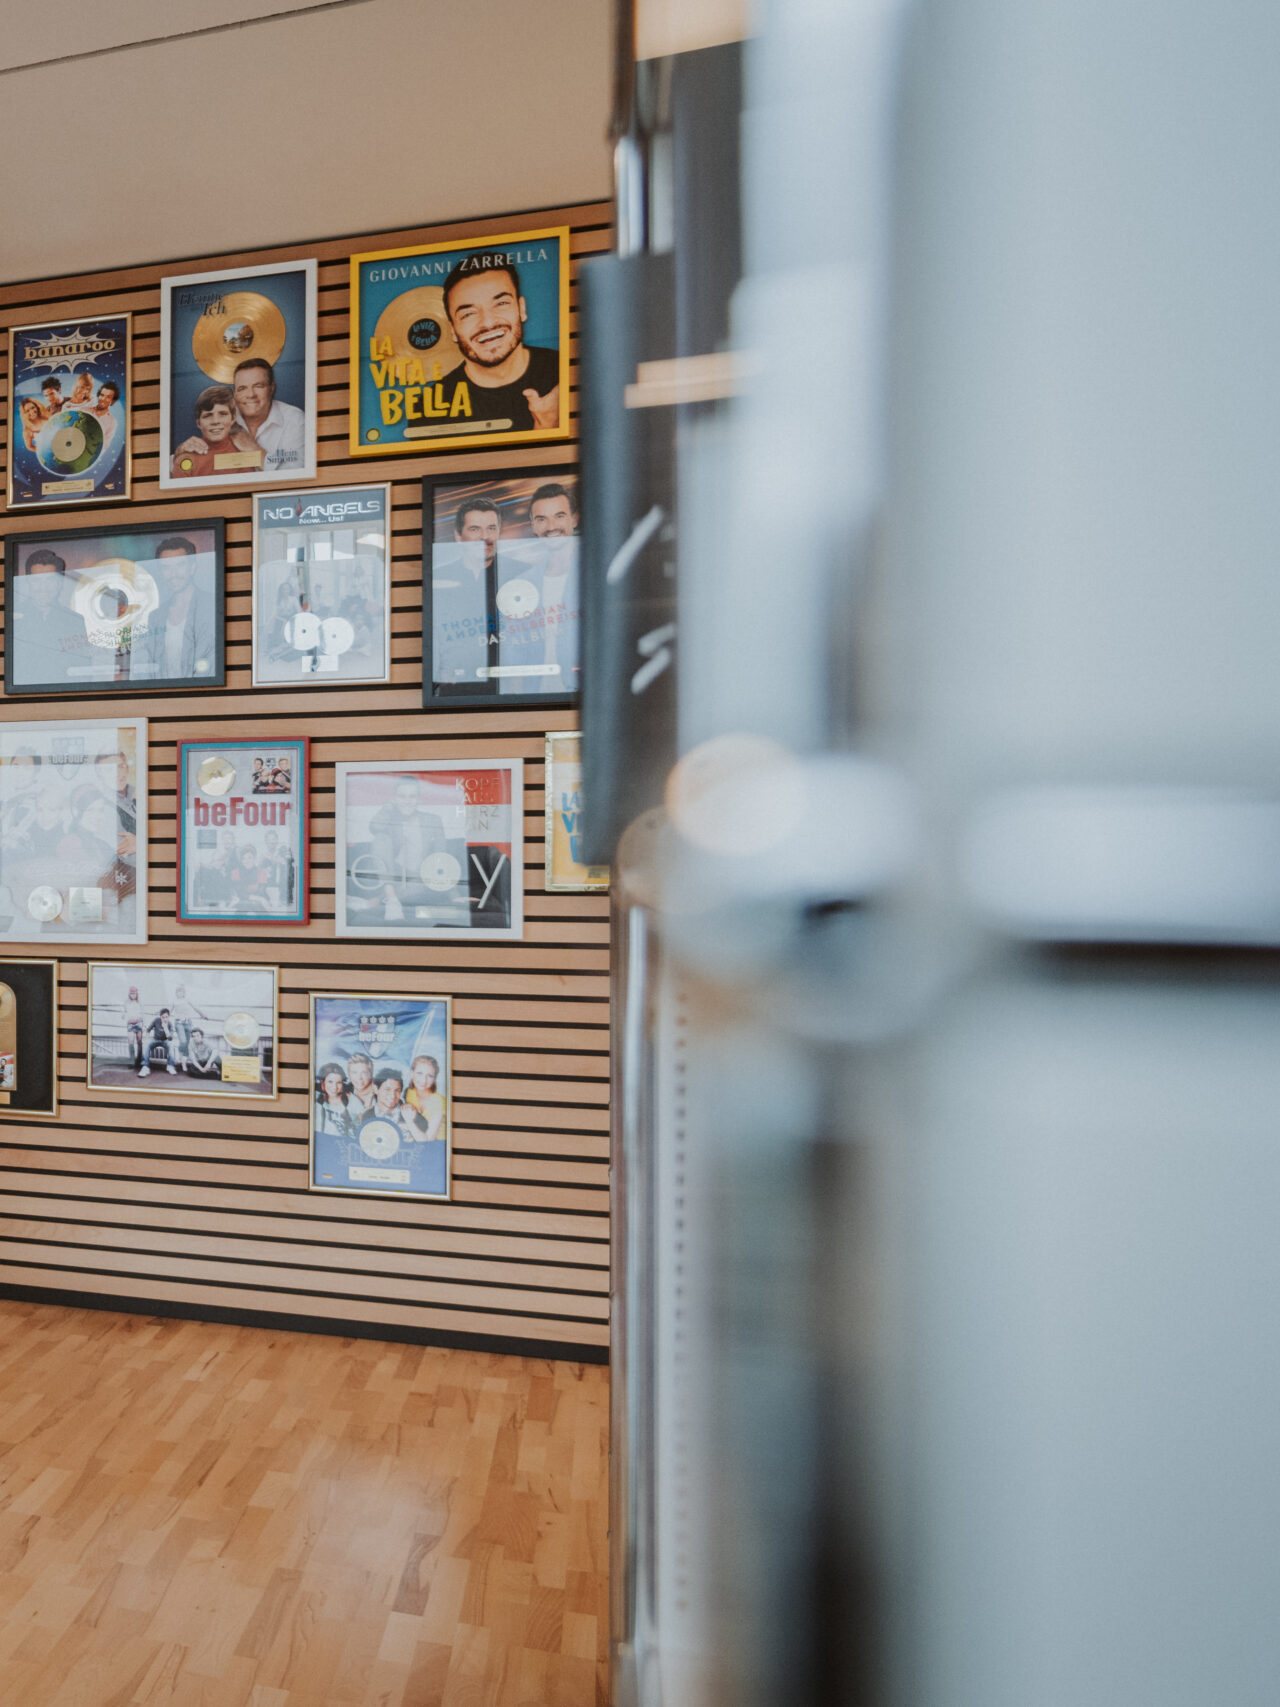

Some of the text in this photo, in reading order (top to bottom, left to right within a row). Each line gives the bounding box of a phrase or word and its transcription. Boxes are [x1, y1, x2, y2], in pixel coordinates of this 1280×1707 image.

[369, 248, 548, 283] GIOVANNI ZARRELLA
[24, 338, 116, 361] banaroo
[369, 335, 394, 361] LA
[369, 357, 427, 389] VITA
[379, 381, 473, 426] BELLA
[263, 500, 380, 521] NO ANGELS
[508, 611, 581, 635] SILBEREIS
[477, 631, 507, 647] DAS
[194, 797, 291, 826] beFour
